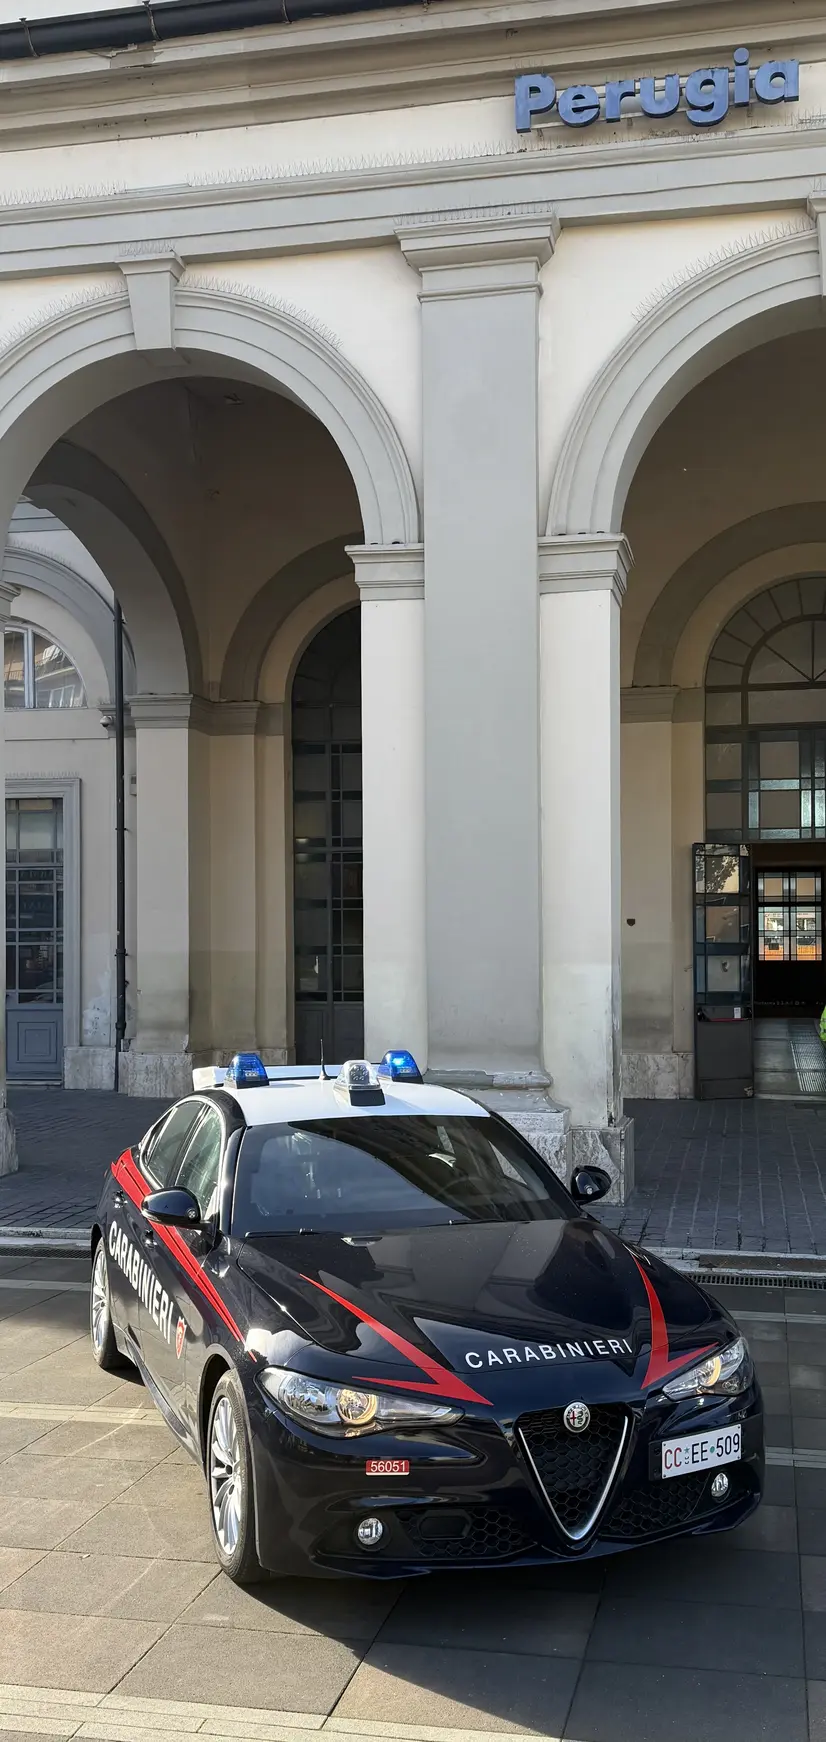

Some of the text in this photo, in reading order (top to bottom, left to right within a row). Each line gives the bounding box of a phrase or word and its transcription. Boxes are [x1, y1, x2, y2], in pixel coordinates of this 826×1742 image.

[514, 47, 800, 133] Perugia
[108, 1220, 174, 1345] CARABINIERI
[464, 1338, 633, 1369] CARABINIERI
[370, 1460, 406, 1472] 56051
[664, 1447, 682, 1469] CC
